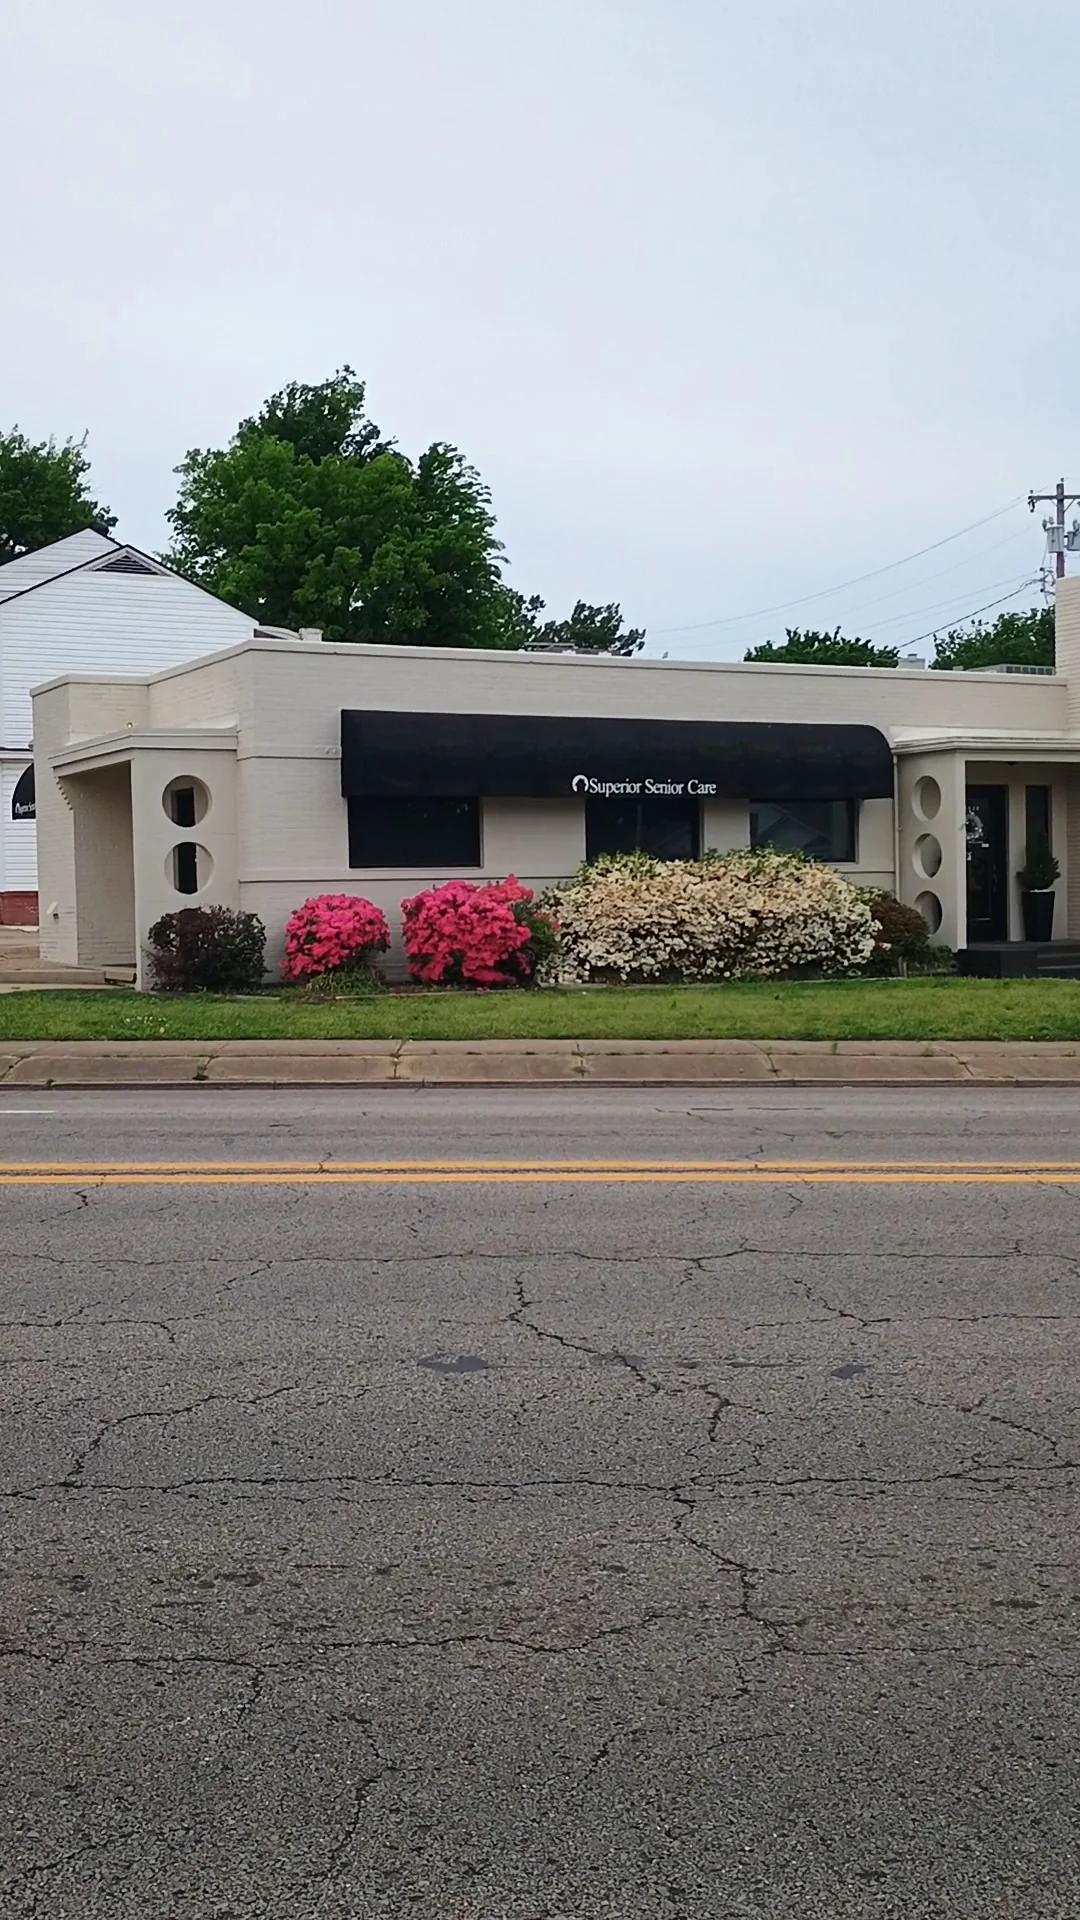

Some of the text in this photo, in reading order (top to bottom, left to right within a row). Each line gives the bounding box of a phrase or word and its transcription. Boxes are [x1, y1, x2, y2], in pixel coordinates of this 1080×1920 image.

[589, 777, 717, 797] Superior Senior Care
